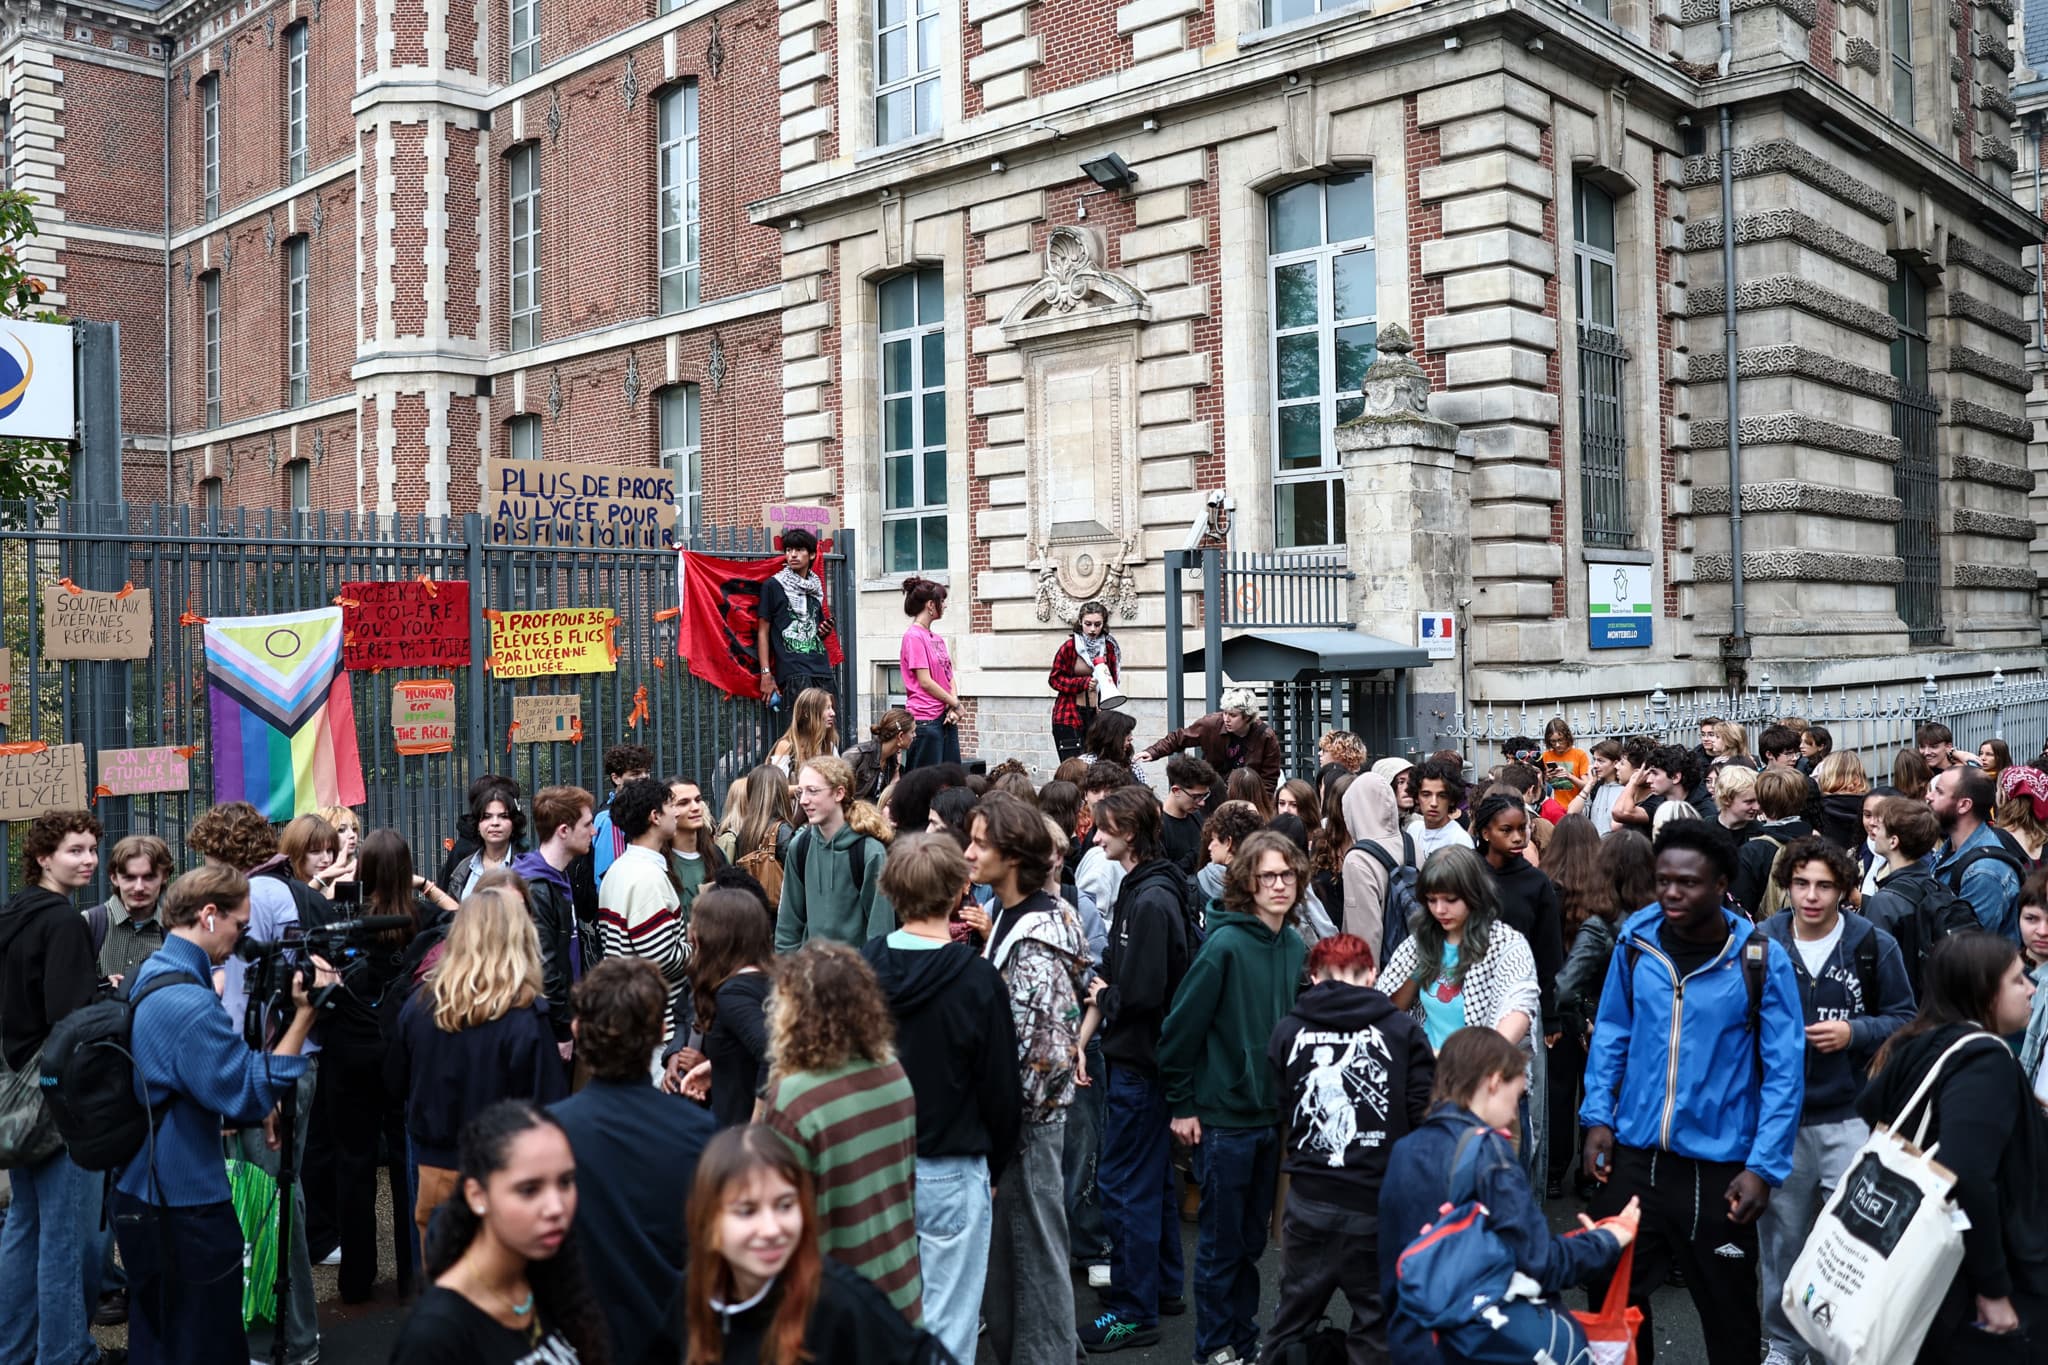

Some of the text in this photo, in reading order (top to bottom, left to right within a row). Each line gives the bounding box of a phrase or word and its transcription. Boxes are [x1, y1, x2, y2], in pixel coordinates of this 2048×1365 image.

[502, 468, 675, 505] PLUS DE PROFS
[498, 500, 526, 520] AU
[608, 503, 658, 526] POUR
[57, 594, 140, 615] SOUTIEN AUX
[510, 613, 551, 630] PROF
[552, 612, 585, 627] POUR
[587, 611, 605, 624] 36
[569, 629, 604, 643] FLICS
[400, 640, 425, 660] PAS
[431, 638, 470, 658] TAIRE
[495, 649, 522, 664] PAR
[405, 687, 454, 701] HUNGRY?
[396, 727, 417, 740] THE
[117, 751, 138, 765] ON
[1286, 1024, 1393, 1067] METALLICA
[1856, 1187, 1883, 1216] FAIR
